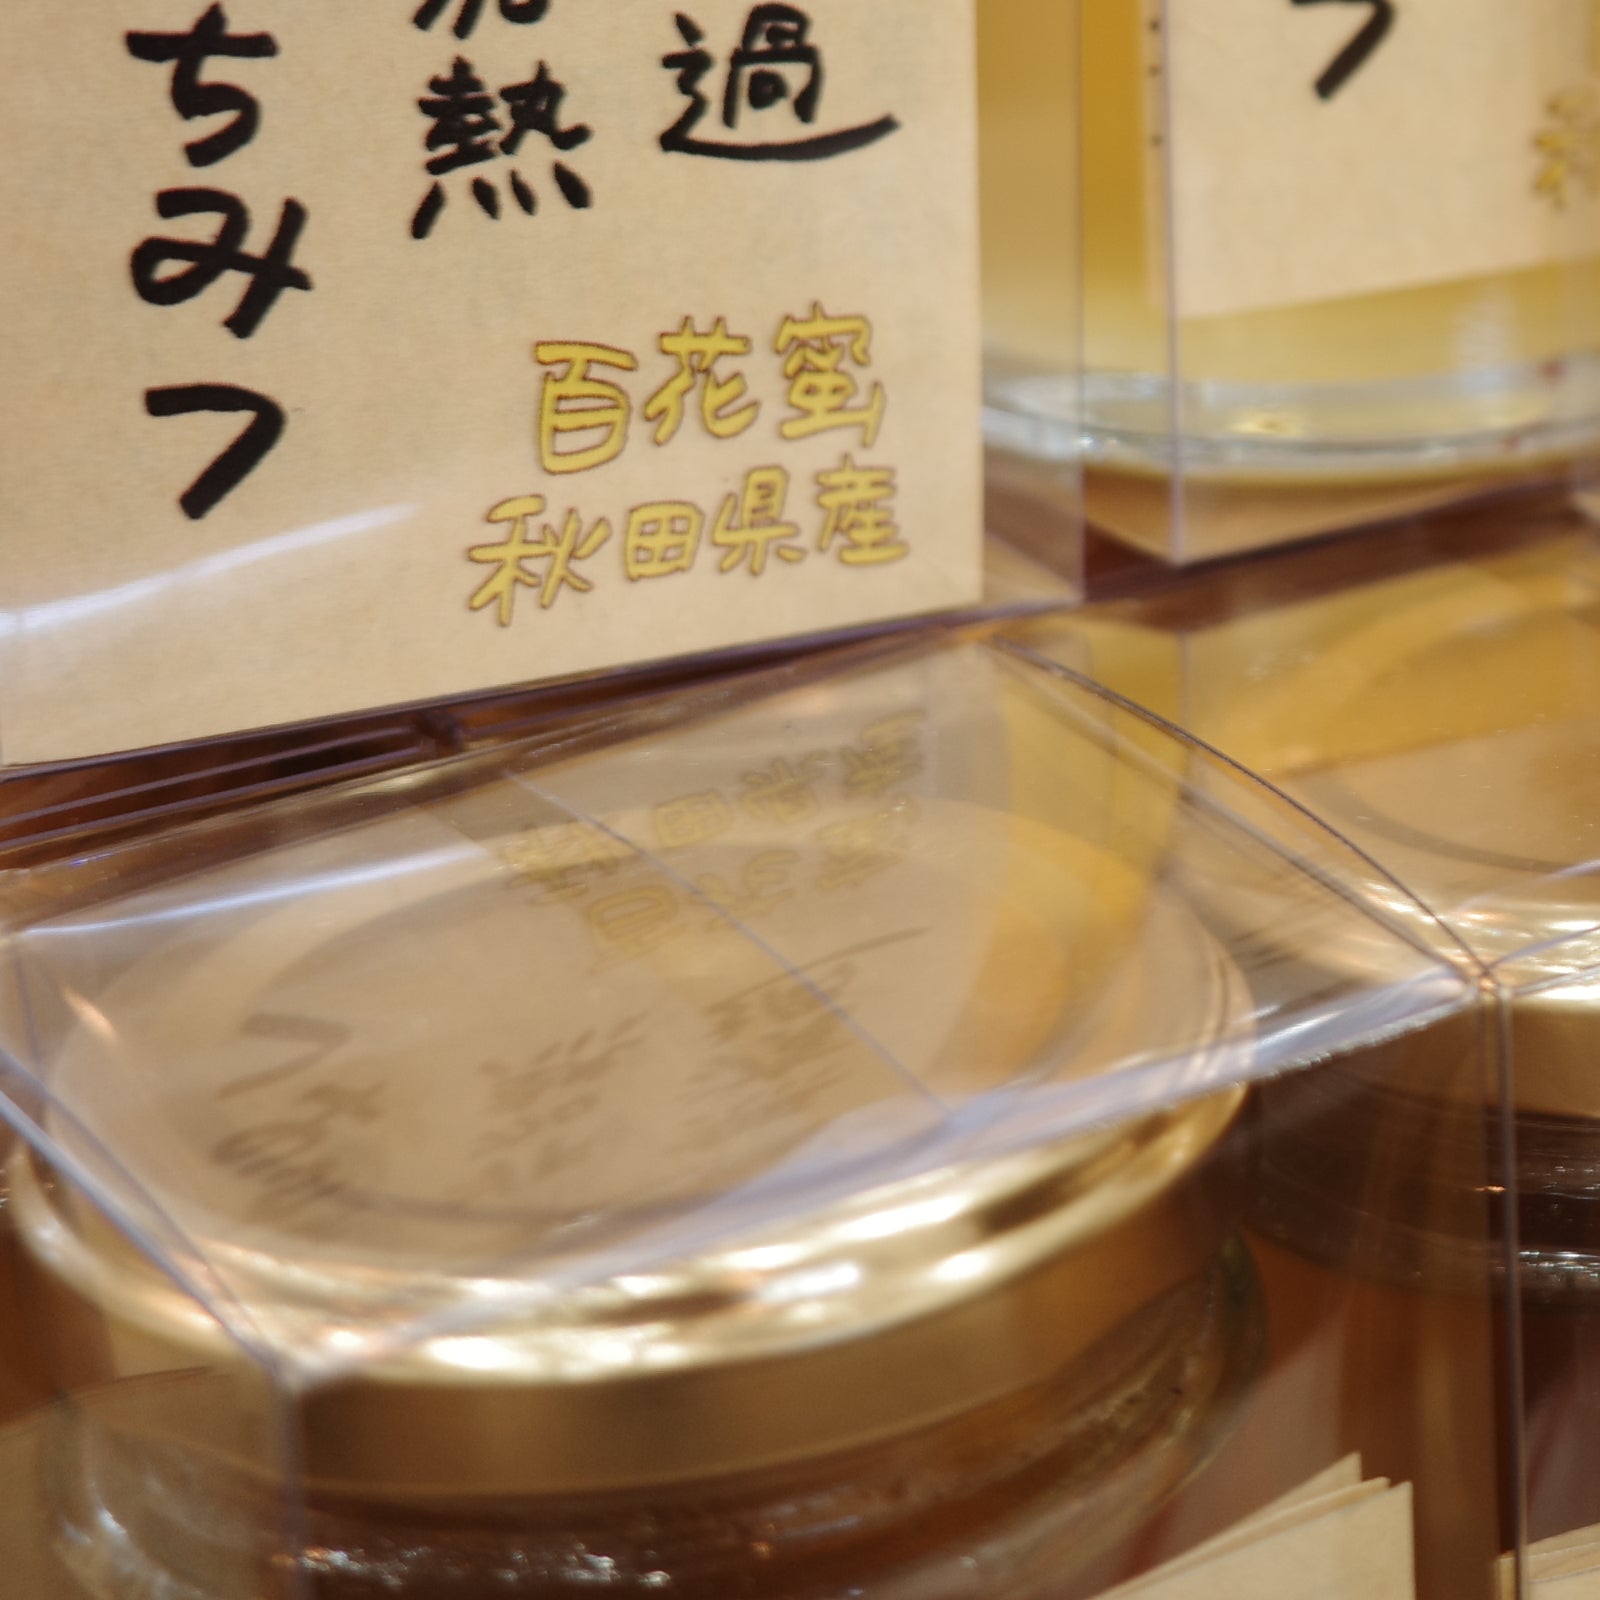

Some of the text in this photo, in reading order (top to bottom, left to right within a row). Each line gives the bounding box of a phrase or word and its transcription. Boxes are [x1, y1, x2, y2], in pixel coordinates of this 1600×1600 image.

[533, 301, 888, 476] 百花蜜
[466, 453, 910, 628] 秋田県産
